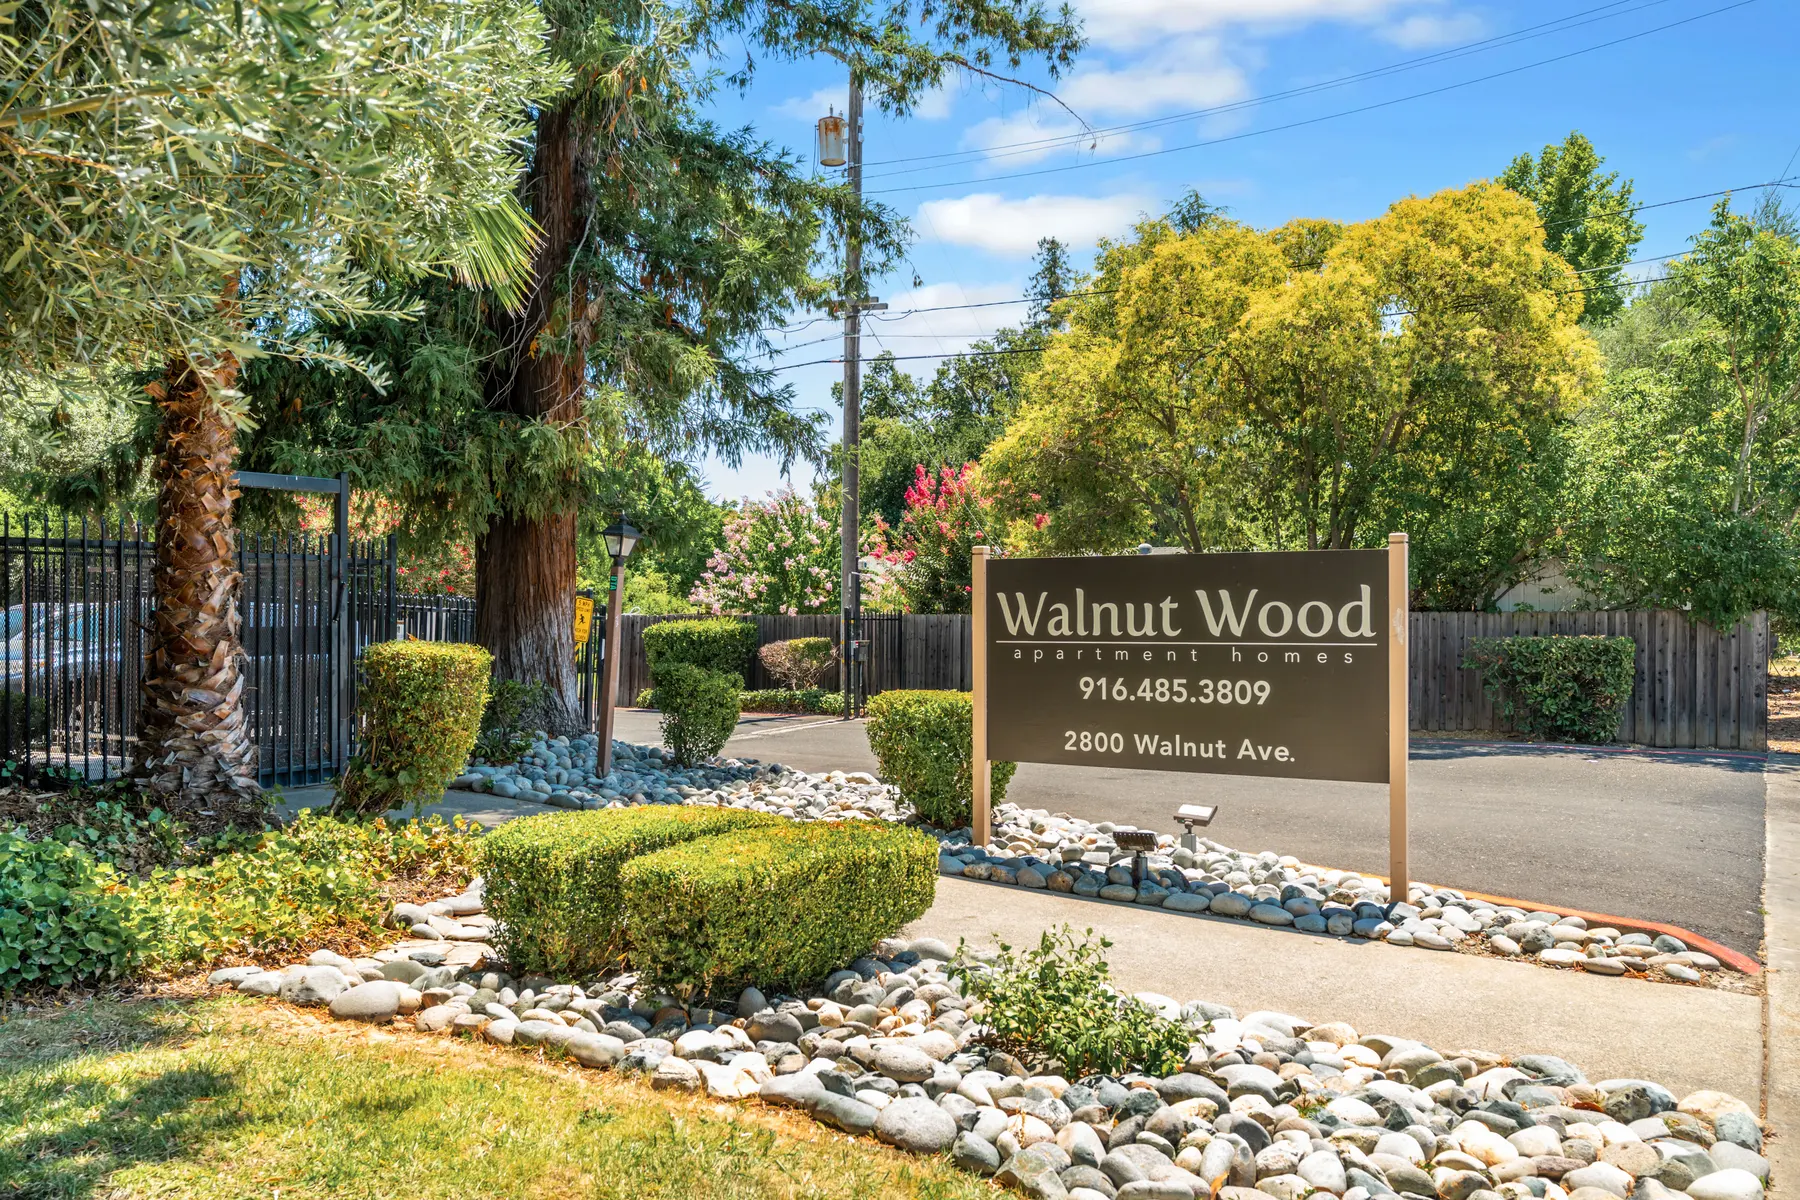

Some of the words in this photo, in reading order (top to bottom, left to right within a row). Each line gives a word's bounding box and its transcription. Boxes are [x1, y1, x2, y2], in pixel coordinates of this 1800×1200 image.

[997, 588, 1181, 636] Walnut
[1195, 584, 1377, 638] Wood
[1013, 647, 1198, 664] apartment
[1231, 646, 1354, 664] homes
[1079, 676, 1271, 706] 916.485.3809
[1064, 730, 1124, 754] 2800
[1134, 733, 1227, 759] Walnut
[1237, 738, 1296, 763] Ave.
